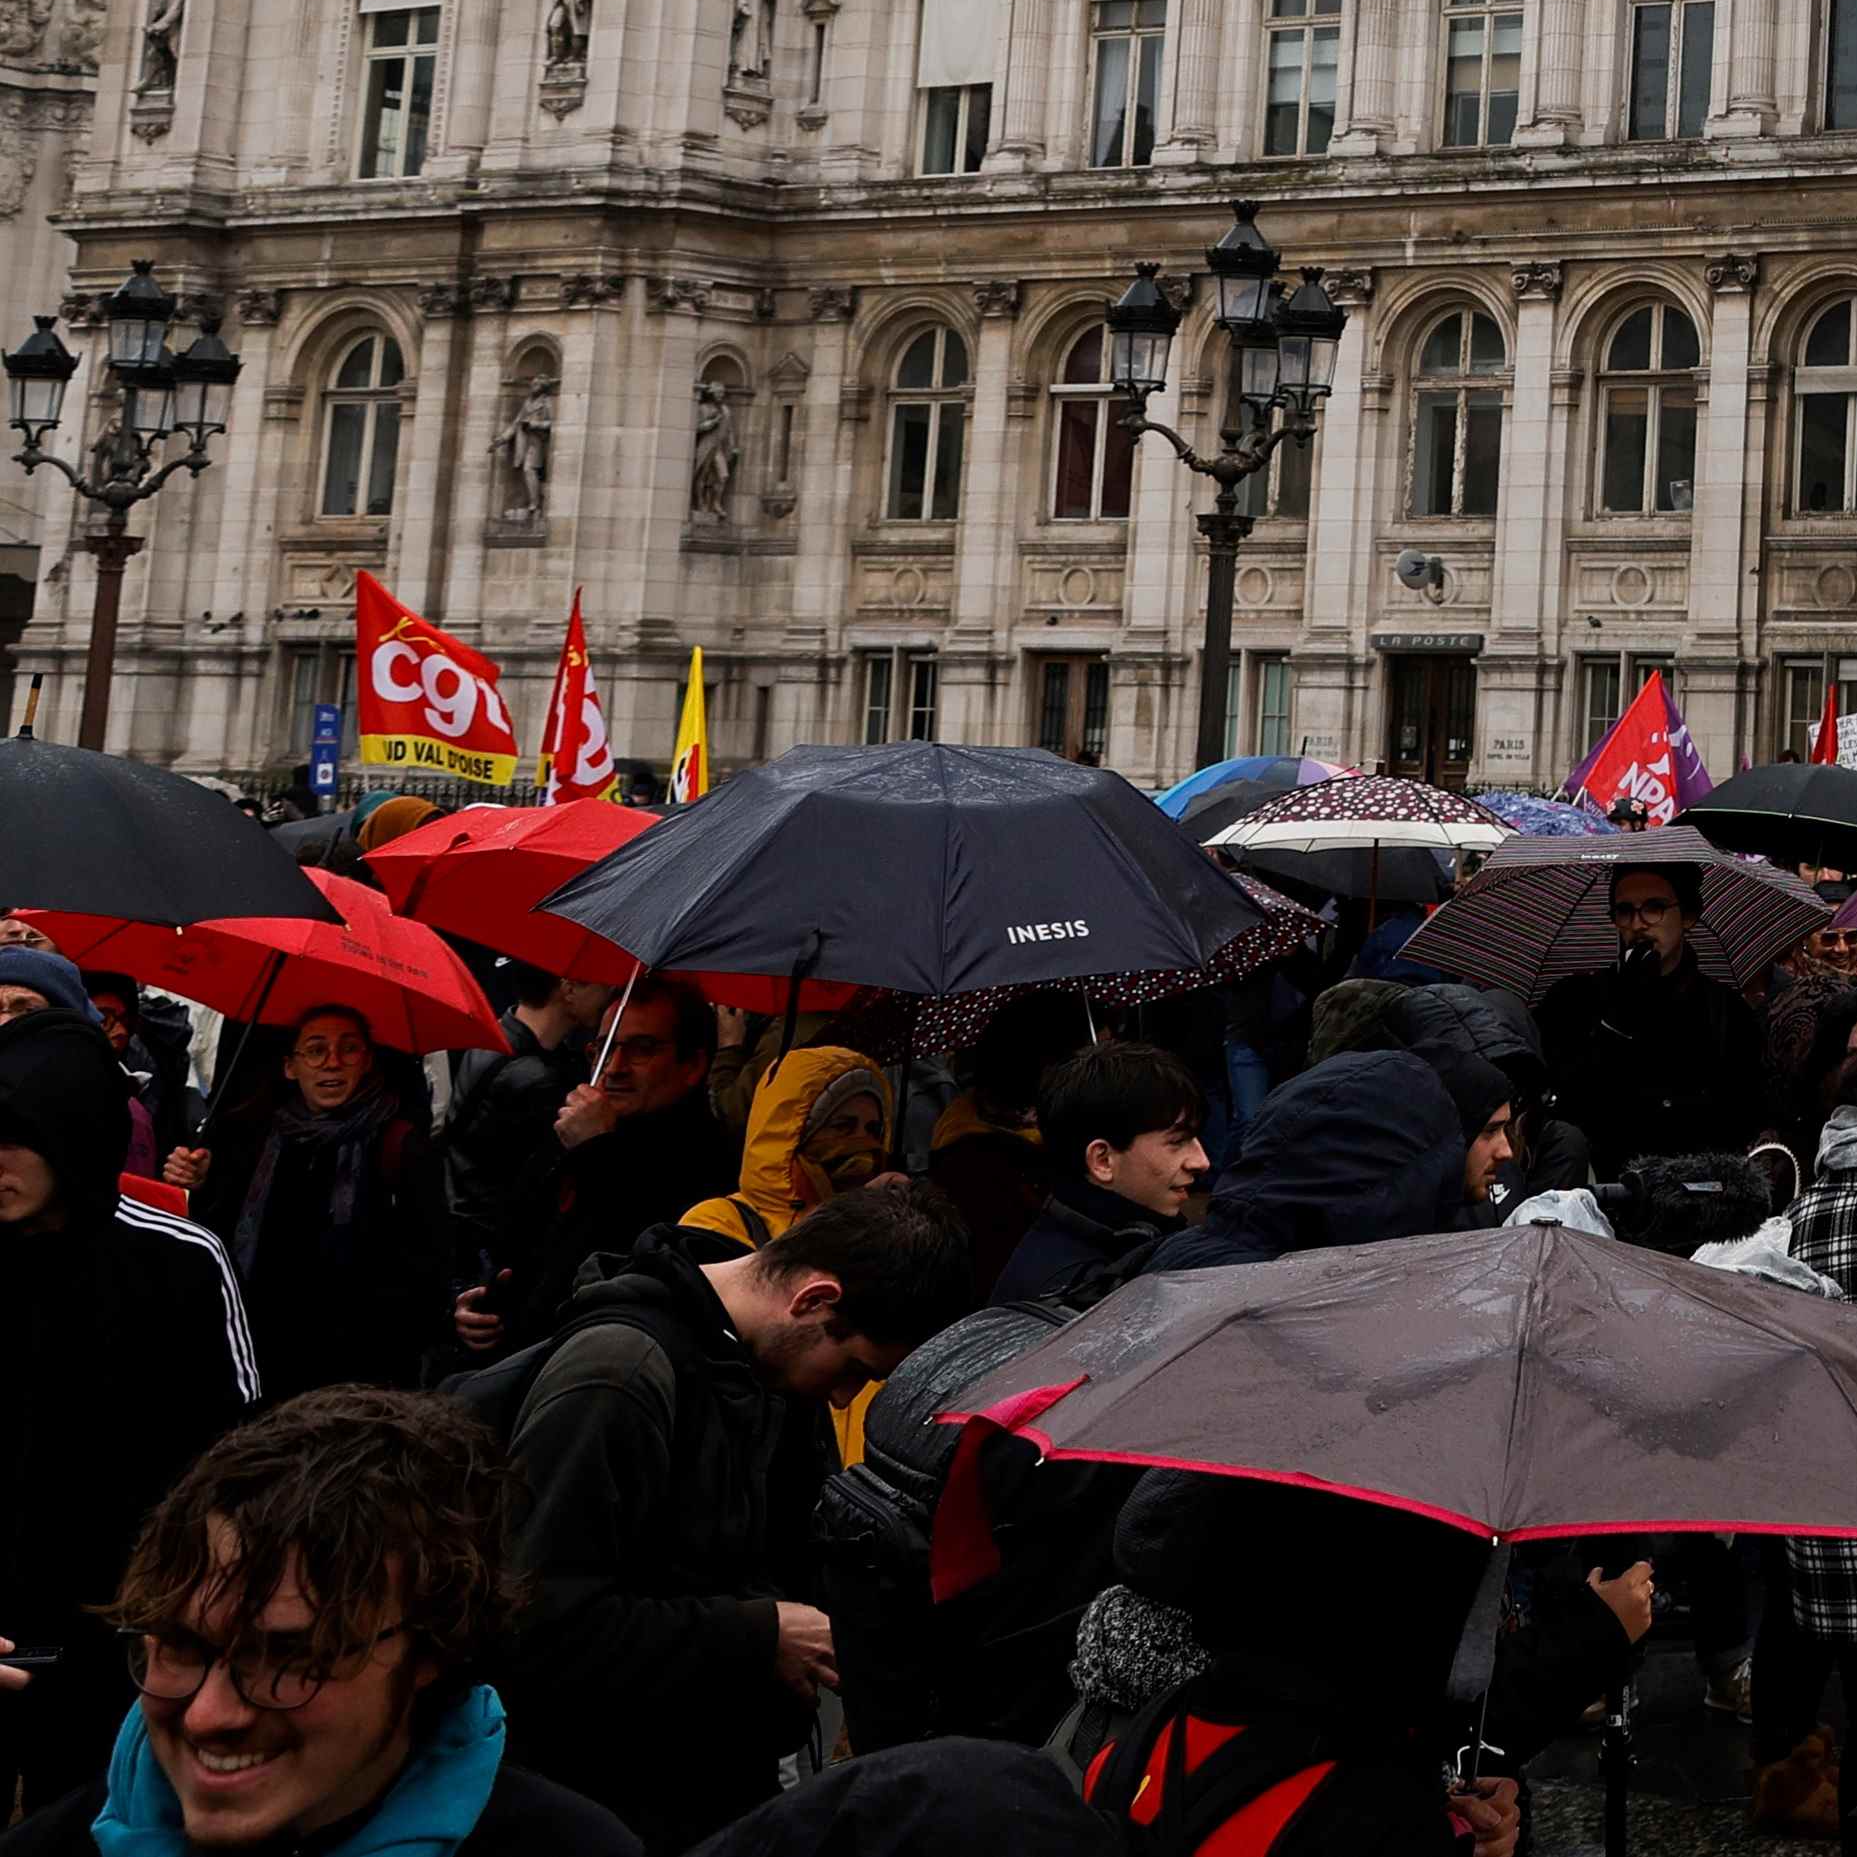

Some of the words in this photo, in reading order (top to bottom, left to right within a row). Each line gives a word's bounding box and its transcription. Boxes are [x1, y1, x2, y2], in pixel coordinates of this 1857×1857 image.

[1379, 636, 1401, 645] LA
[1411, 635, 1472, 646] POSTE
[413, 742, 445, 766] VAL
[1618, 761, 1674, 826] NPA
[1007, 918, 1091, 946] INESIS
